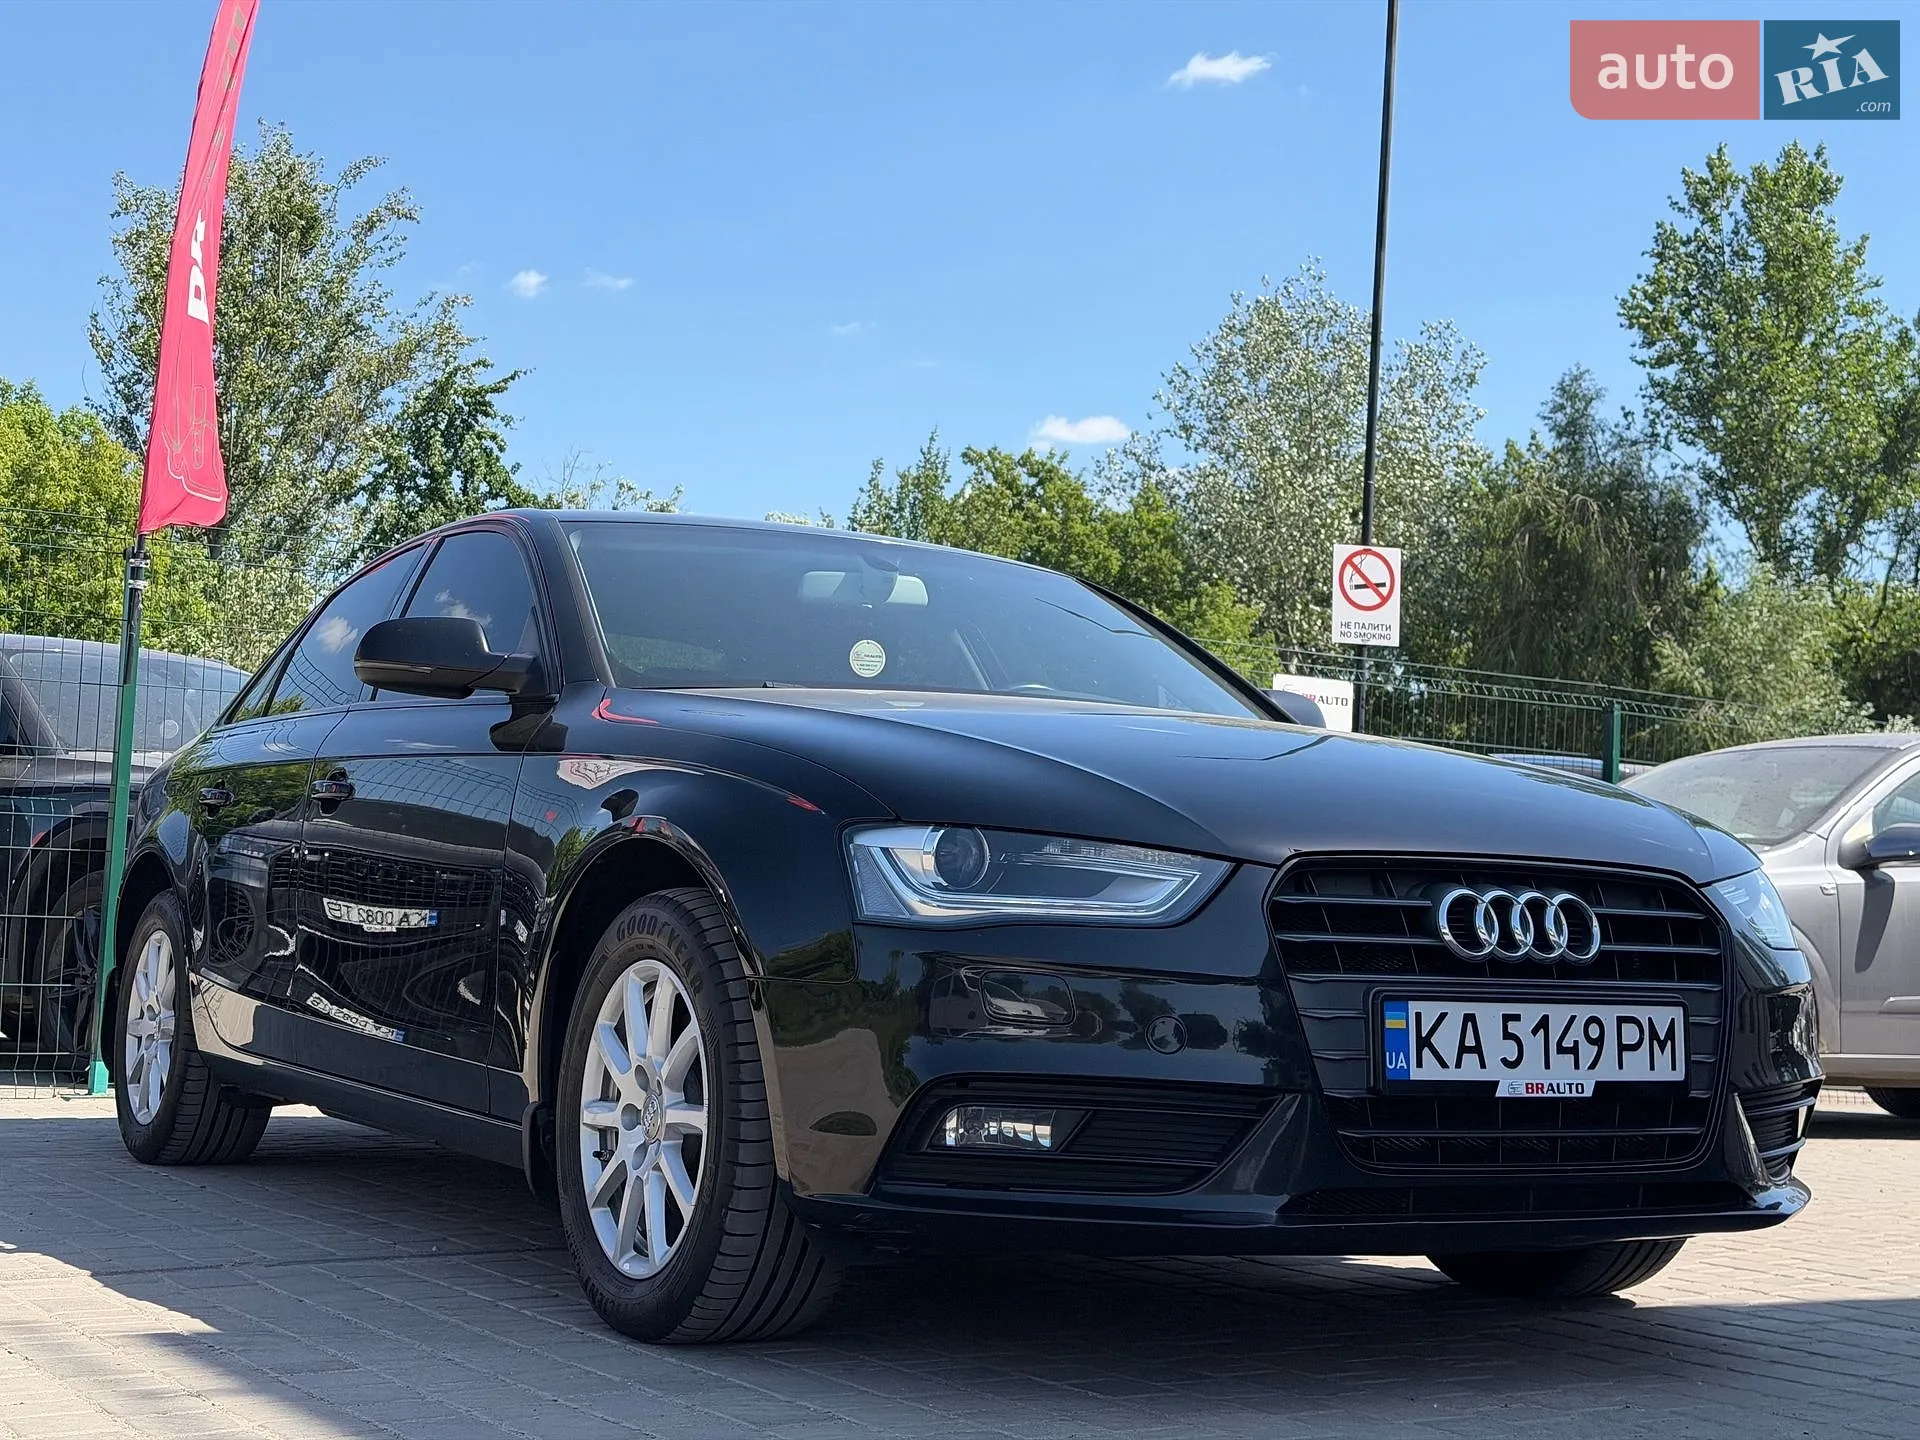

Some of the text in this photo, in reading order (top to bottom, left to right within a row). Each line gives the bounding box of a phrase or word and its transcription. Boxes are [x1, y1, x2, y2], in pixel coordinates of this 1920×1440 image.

[1340, 621, 1391, 632] НЕ ПАЛИТИ
[1340, 630, 1391, 641] NO SMOKING
[1414, 1011, 1677, 1072] KA 5149 PM
[1386, 1051, 1408, 1070] UA
[1525, 1081, 1585, 1096] BRAUTO
